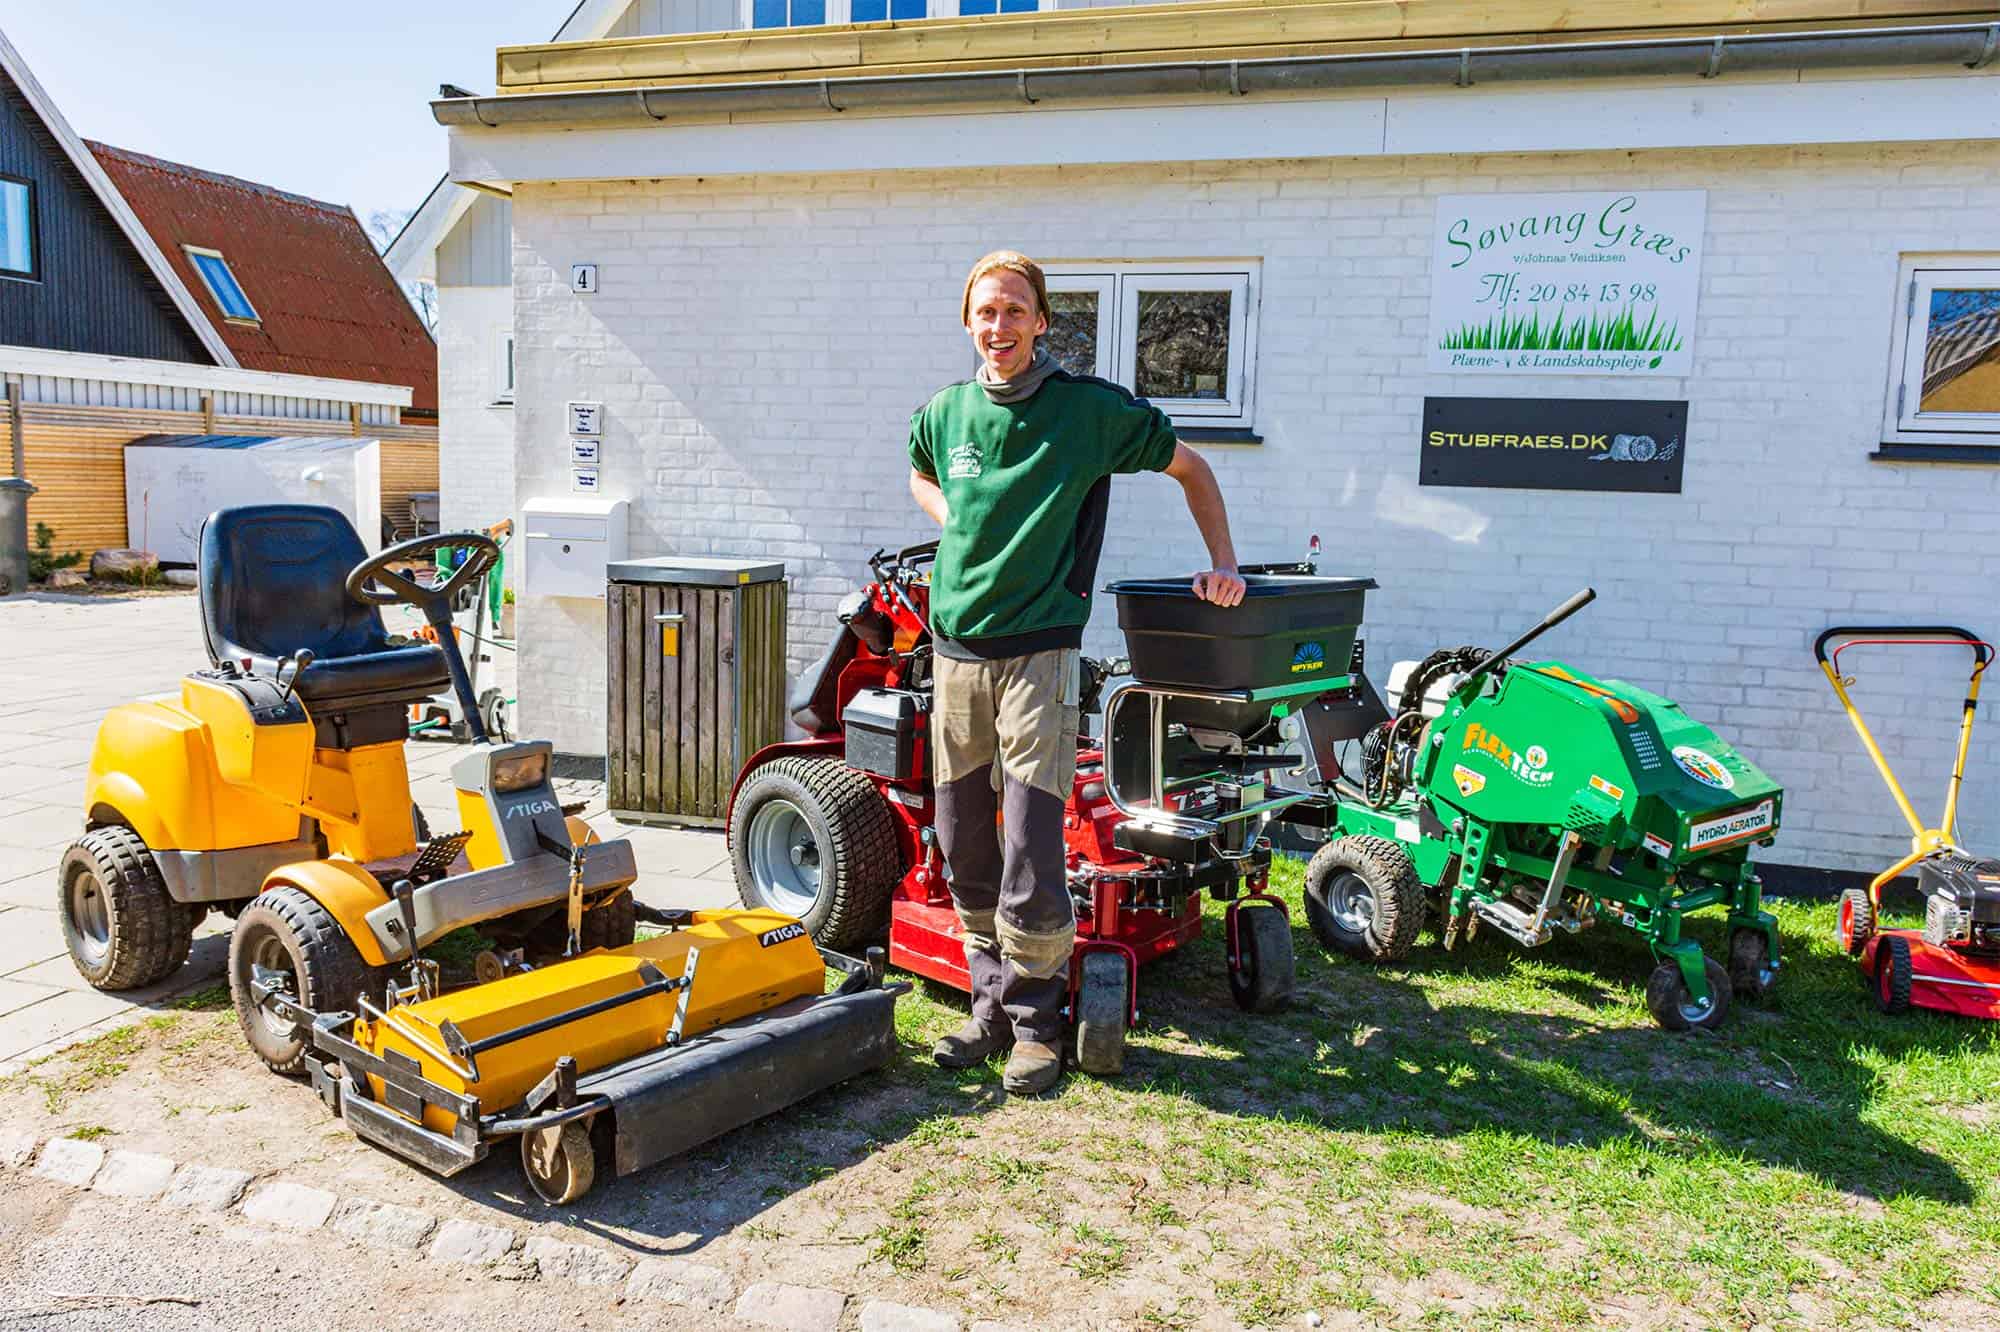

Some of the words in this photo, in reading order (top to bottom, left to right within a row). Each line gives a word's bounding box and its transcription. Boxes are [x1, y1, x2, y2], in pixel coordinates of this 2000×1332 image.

[1594, 195, 1691, 264] Græs
[577, 269, 588, 289] 4
[1475, 272, 1521, 310] Tlf:
[1527, 283, 1557, 303] 20
[1562, 283, 1592, 303] 84
[1599, 283, 1620, 303] 13
[1629, 283, 1657, 303] 98
[1517, 354, 1532, 368] &
[1533, 354, 1647, 371] Landskabspleje
[505, 800, 557, 820] STIGA
[1696, 823, 1728, 842] HYDRO
[1728, 813, 1767, 832] AERATOR
[762, 923, 806, 947] STIGA
